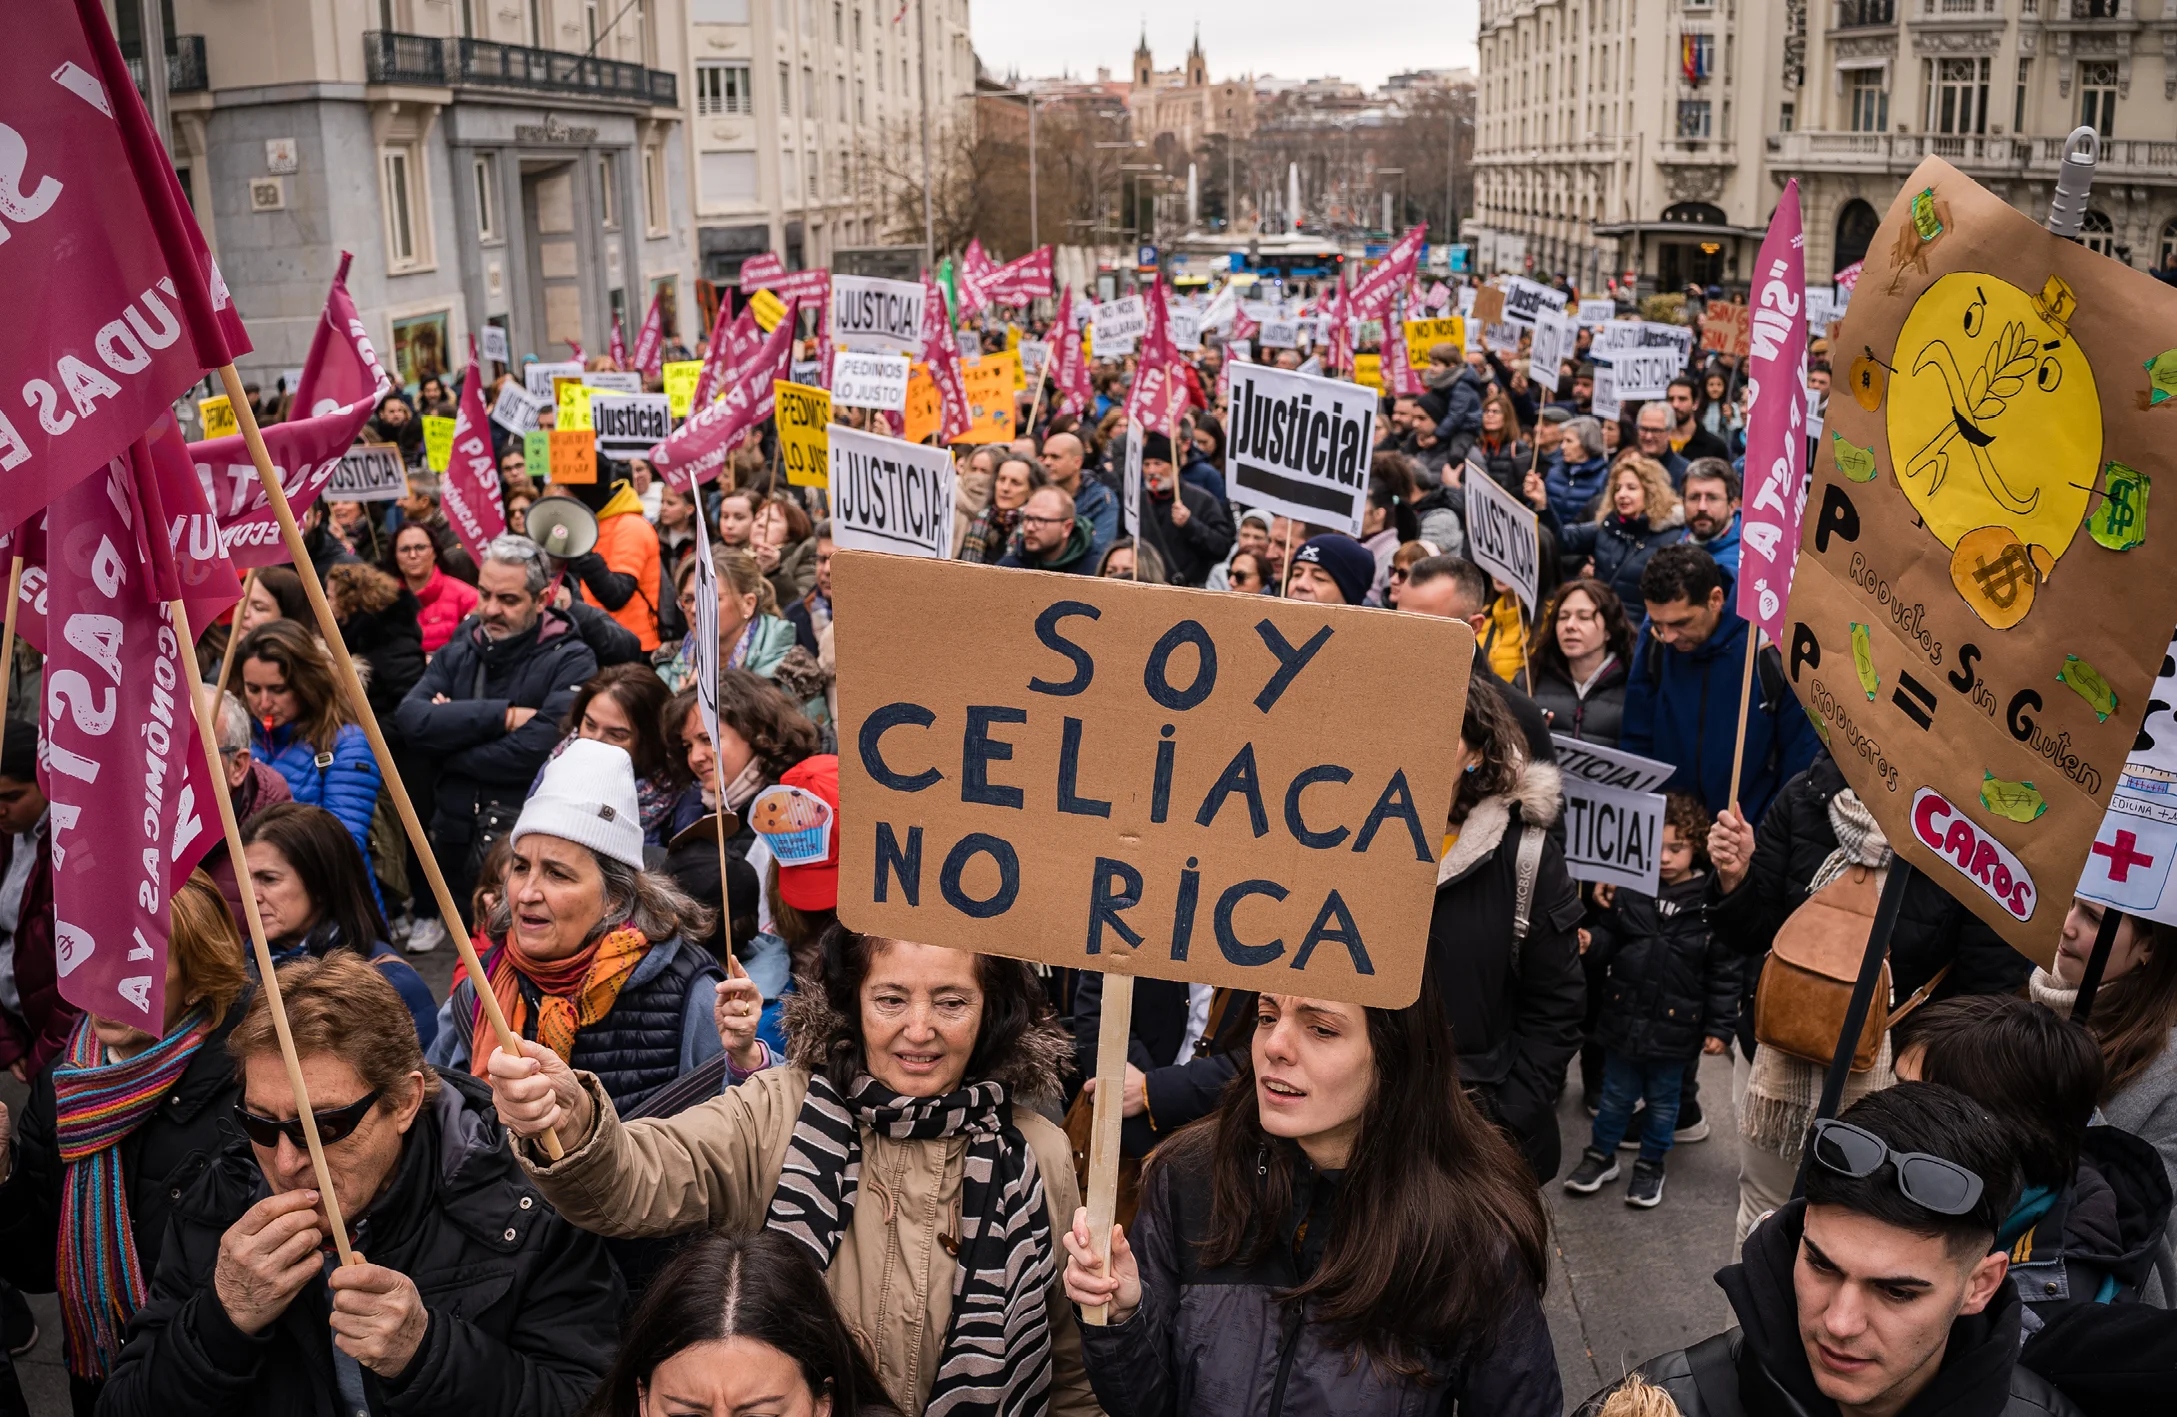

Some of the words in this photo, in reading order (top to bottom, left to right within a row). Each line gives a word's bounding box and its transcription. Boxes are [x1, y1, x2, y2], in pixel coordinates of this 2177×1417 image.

[836, 289, 921, 337] ¡JUSTICIA!
[594, 403, 669, 437] ¡Justicia!
[784, 442, 804, 472] LO
[1229, 379, 1372, 490] ¡Justicia!
[1026, 600, 1335, 714] SOY
[873, 821, 1020, 919] NO
[1566, 796, 1655, 872] TICIA!
[1914, 794, 2032, 917] CAROS
